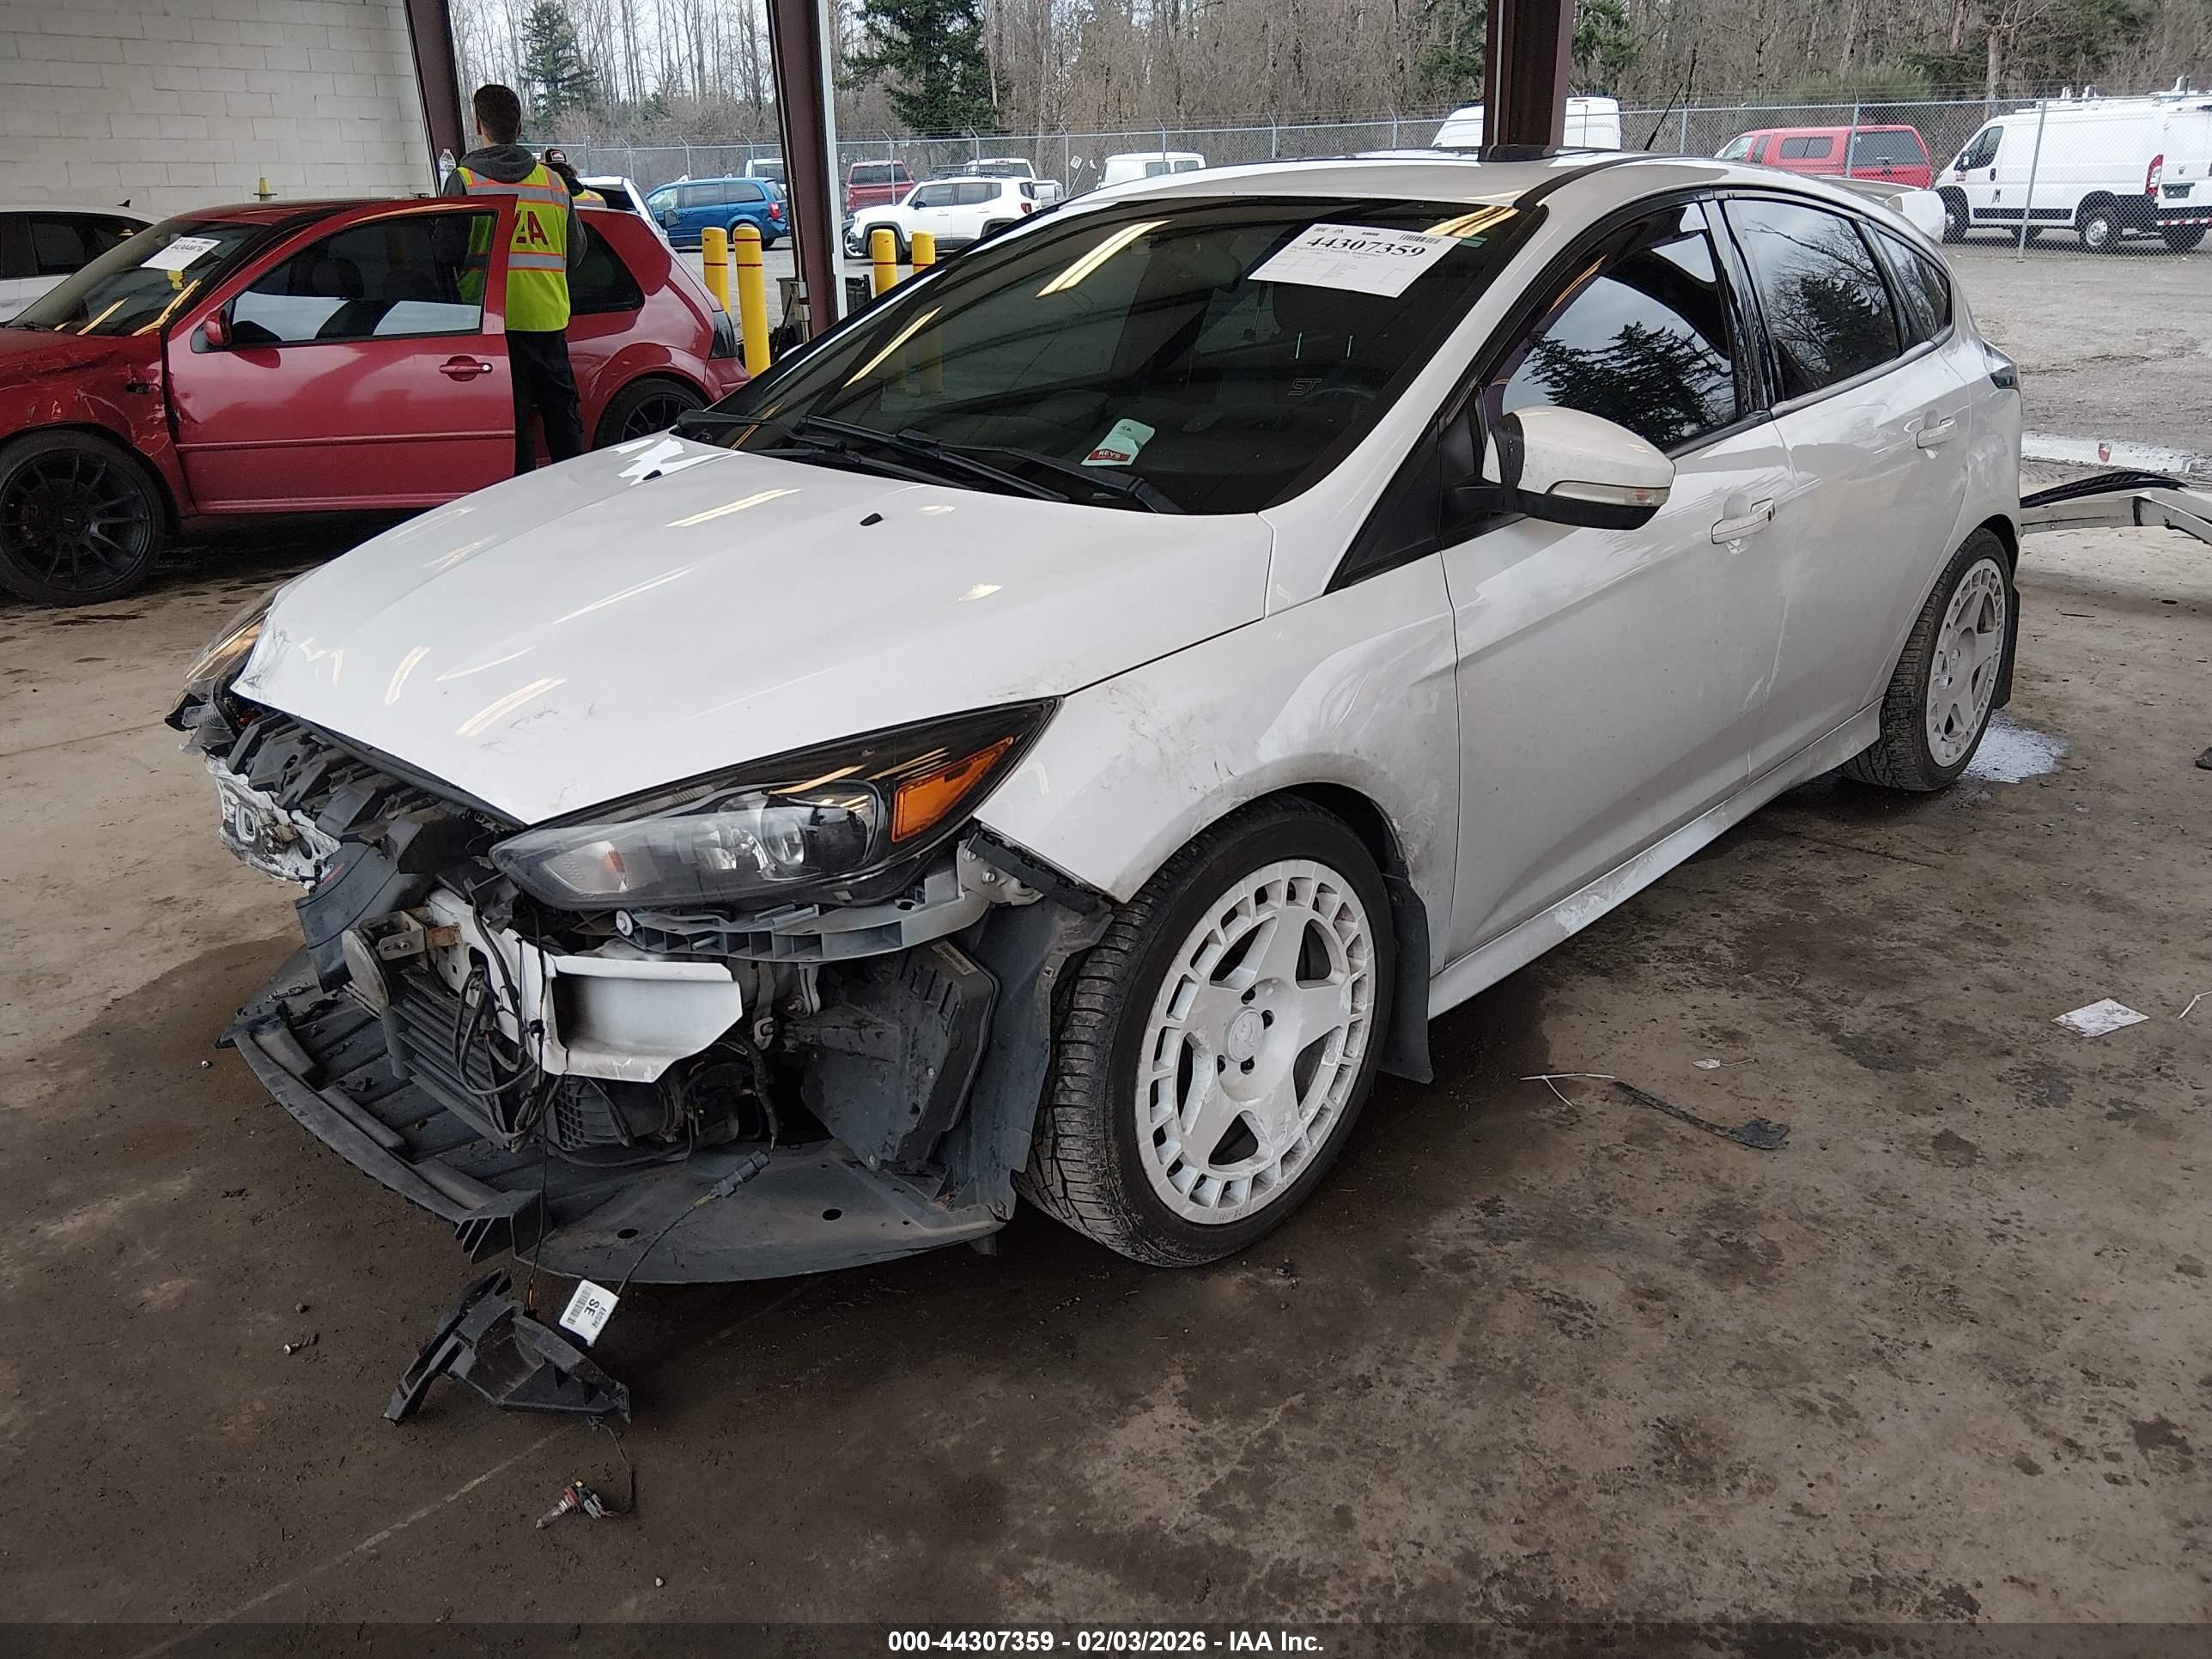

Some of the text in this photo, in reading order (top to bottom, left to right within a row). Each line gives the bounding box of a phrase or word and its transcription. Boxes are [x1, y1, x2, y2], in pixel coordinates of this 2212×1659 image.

[1306, 236, 1426, 258] 44307359
[1287, 378, 1322, 397] ST
[1098, 450, 1121, 459] KEYS
[584, 1297, 600, 1317] SE
